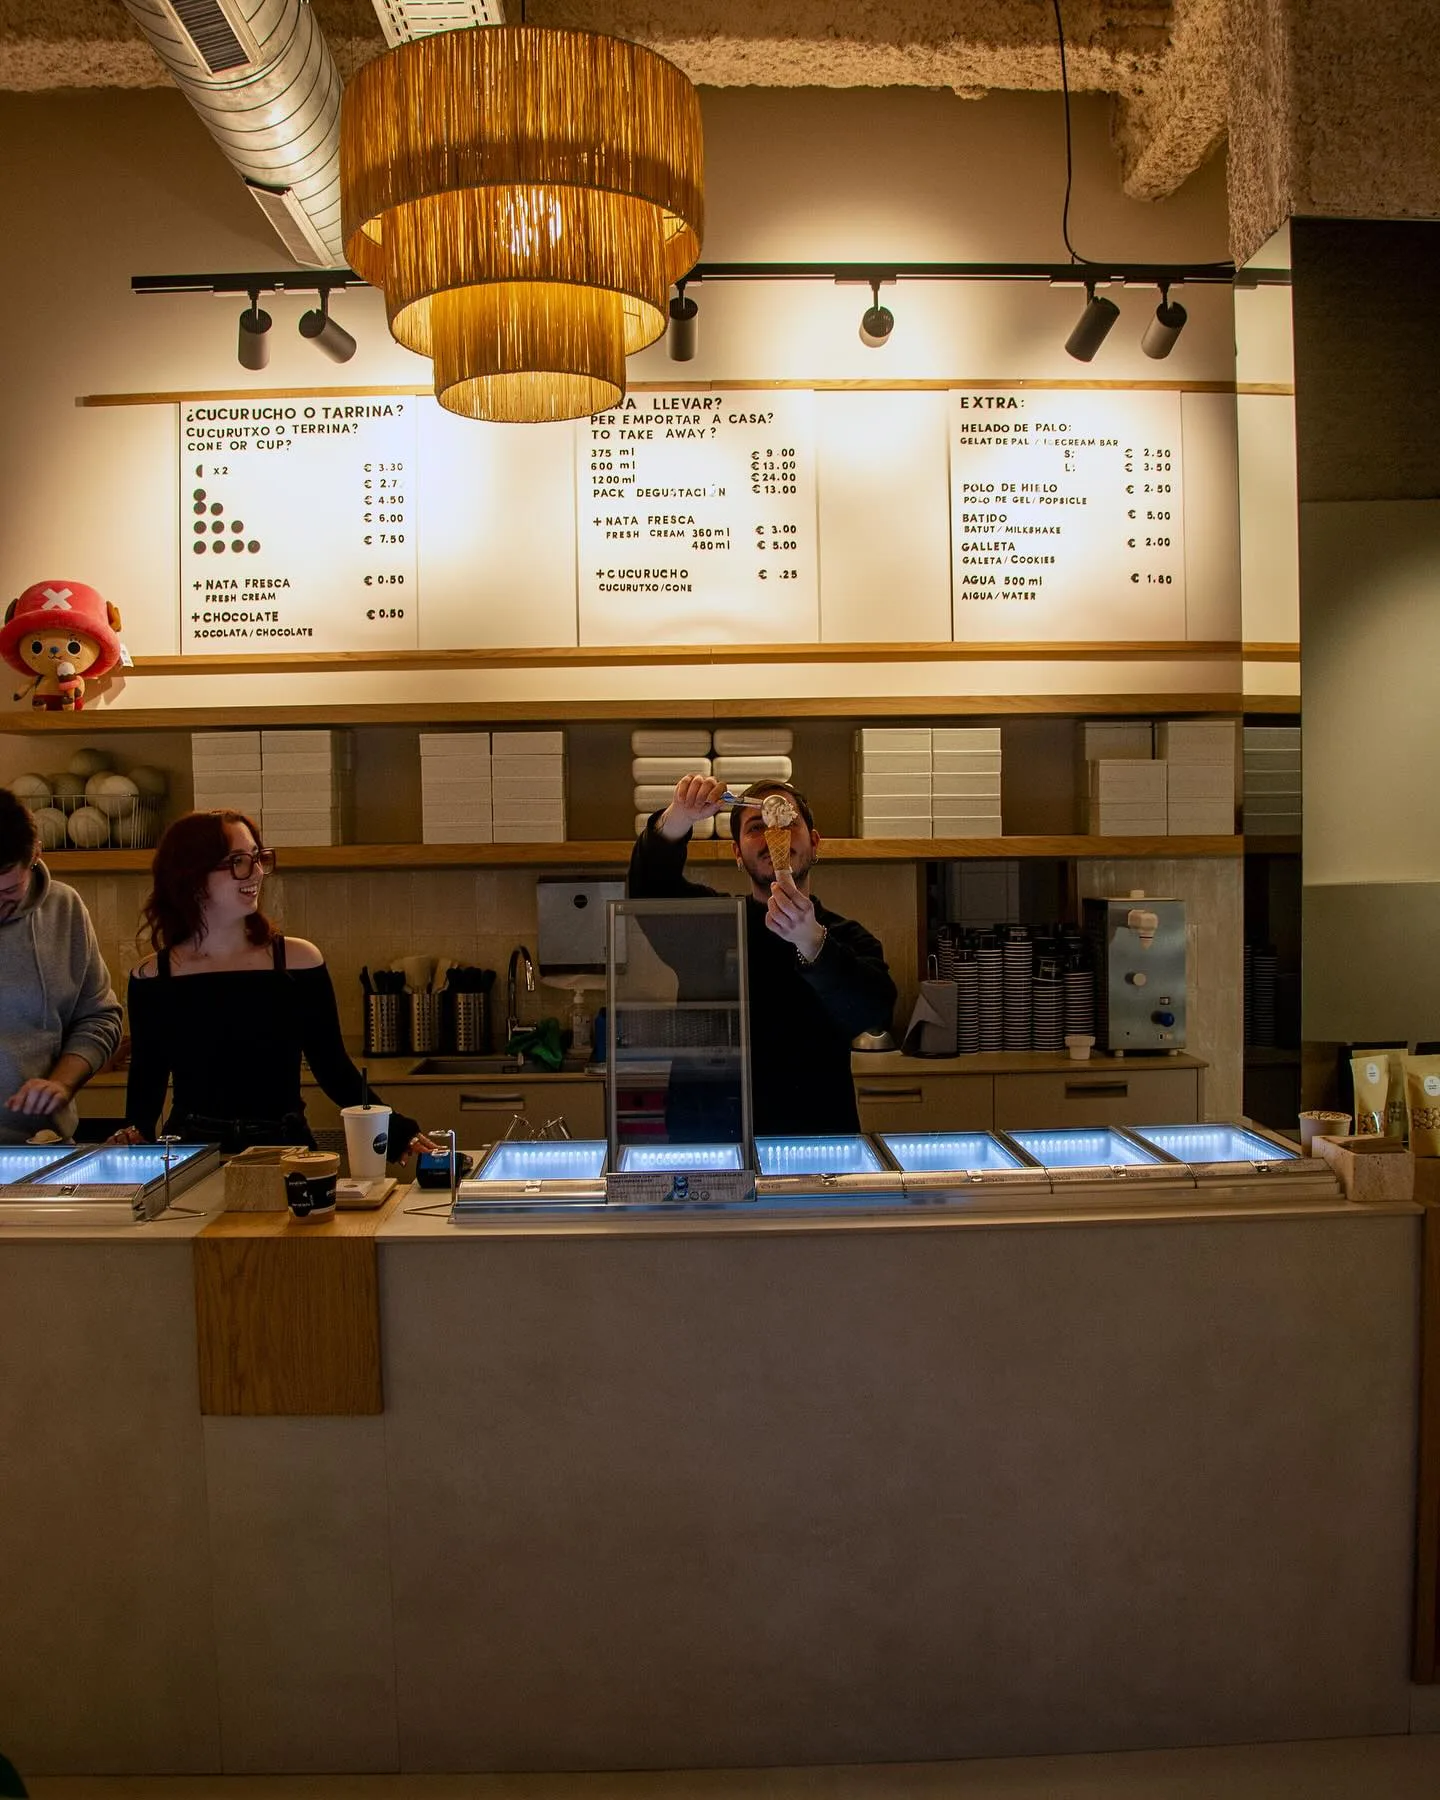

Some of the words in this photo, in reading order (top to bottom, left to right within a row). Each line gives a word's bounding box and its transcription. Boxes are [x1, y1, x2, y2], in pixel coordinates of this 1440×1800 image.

[653, 397, 722, 410] LLEVAR?
[961, 396, 1024, 409] EXTRA:
[304, 407, 316, 418] O
[322, 405, 403, 419] TARRINA?
[590, 415, 615, 425] PER
[623, 415, 700, 424] EMPORTAR
[712, 414, 721, 424] A
[729, 413, 773, 424] CASA?
[186, 426, 270, 438] CUCURUTXO
[275, 425, 285, 435] O
[292, 423, 358, 434] TERRINA?
[962, 424, 1010, 433] HELADO
[1014, 424, 1028, 432] DE
[1036, 423, 1071, 432] PALO:
[592, 430, 610, 439] TO
[619, 430, 653, 440] TAKE
[188, 442, 222, 451] CONE
[230, 441, 247, 450] OR
[256, 440, 292, 450] CUP?
[960, 437, 992, 445] GELAT
[592, 449, 611, 457] 375
[751, 451, 759, 460] €
[1064, 450, 1074, 458] S:
[1144, 448, 1170, 458] 2.50
[379, 463, 403, 471] 3.30
[591, 462, 612, 470] 600
[751, 461, 759, 471] €
[763, 461, 796, 470] 13.00
[1065, 463, 1075, 472] L:
[1144, 463, 1171, 472] 3.50
[751, 473, 759, 482] €
[762, 473, 796, 481] 24.00
[593, 489, 624, 498] PACK
[752, 484, 760, 494] €
[765, 485, 796, 494] 13.00
[963, 483, 994, 493] POLO
[1001, 483, 1016, 492] DE
[1144, 484, 1171, 493] 2.50
[378, 496, 404, 504] 4.50
[379, 514, 403, 523] 6.00
[648, 515, 695, 525] FRESCA
[963, 514, 1007, 523] BATIDO
[1147, 511, 1170, 520] 5.00
[606, 531, 639, 539] FRESH
[650, 529, 685, 537] CREAM
[755, 526, 764, 535] €
[772, 525, 796, 534] 3.00
[380, 534, 404, 543] 7.50
[757, 540, 765, 550] €
[773, 541, 796, 550] 5.00
[961, 542, 1015, 552] GALLETA
[1146, 537, 1170, 547] 2.00
[758, 569, 767, 580] €
[245, 578, 290, 588] FRESCA
[378, 575, 404, 584] 0.50
[962, 575, 995, 585] AGUA
[206, 594, 236, 603] FRESH
[242, 592, 276, 601] CREAM
[379, 609, 404, 619] 0.50
